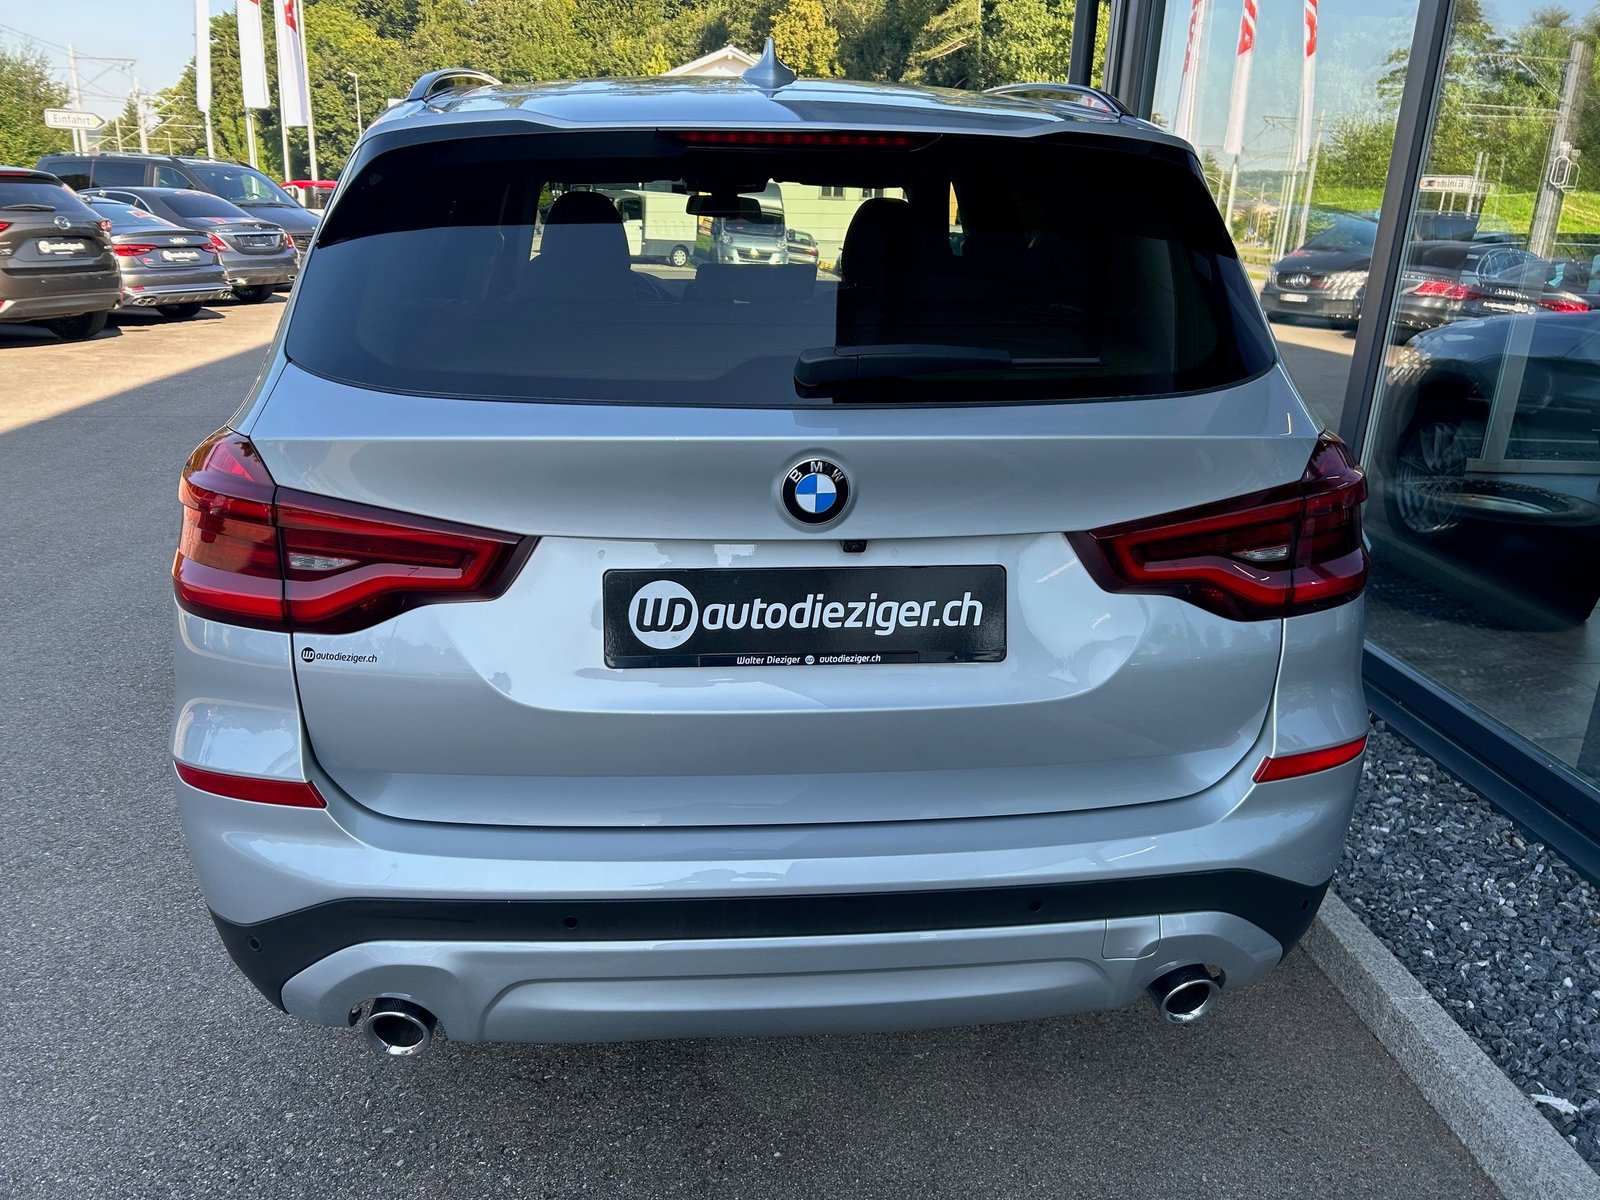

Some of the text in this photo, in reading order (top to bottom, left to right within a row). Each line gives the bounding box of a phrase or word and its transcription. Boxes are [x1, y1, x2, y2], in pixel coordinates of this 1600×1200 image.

[53, 113, 91, 126] Einfahrt
[789, 461, 844, 484] BMW
[702, 591, 983, 636] autodieziger.ch
[316, 652, 378, 664] autodieziger.ch
[736, 656, 765, 665] Walter
[766, 655, 801, 666] Dieziger
[819, 654, 881, 665] autodieziger.ch
